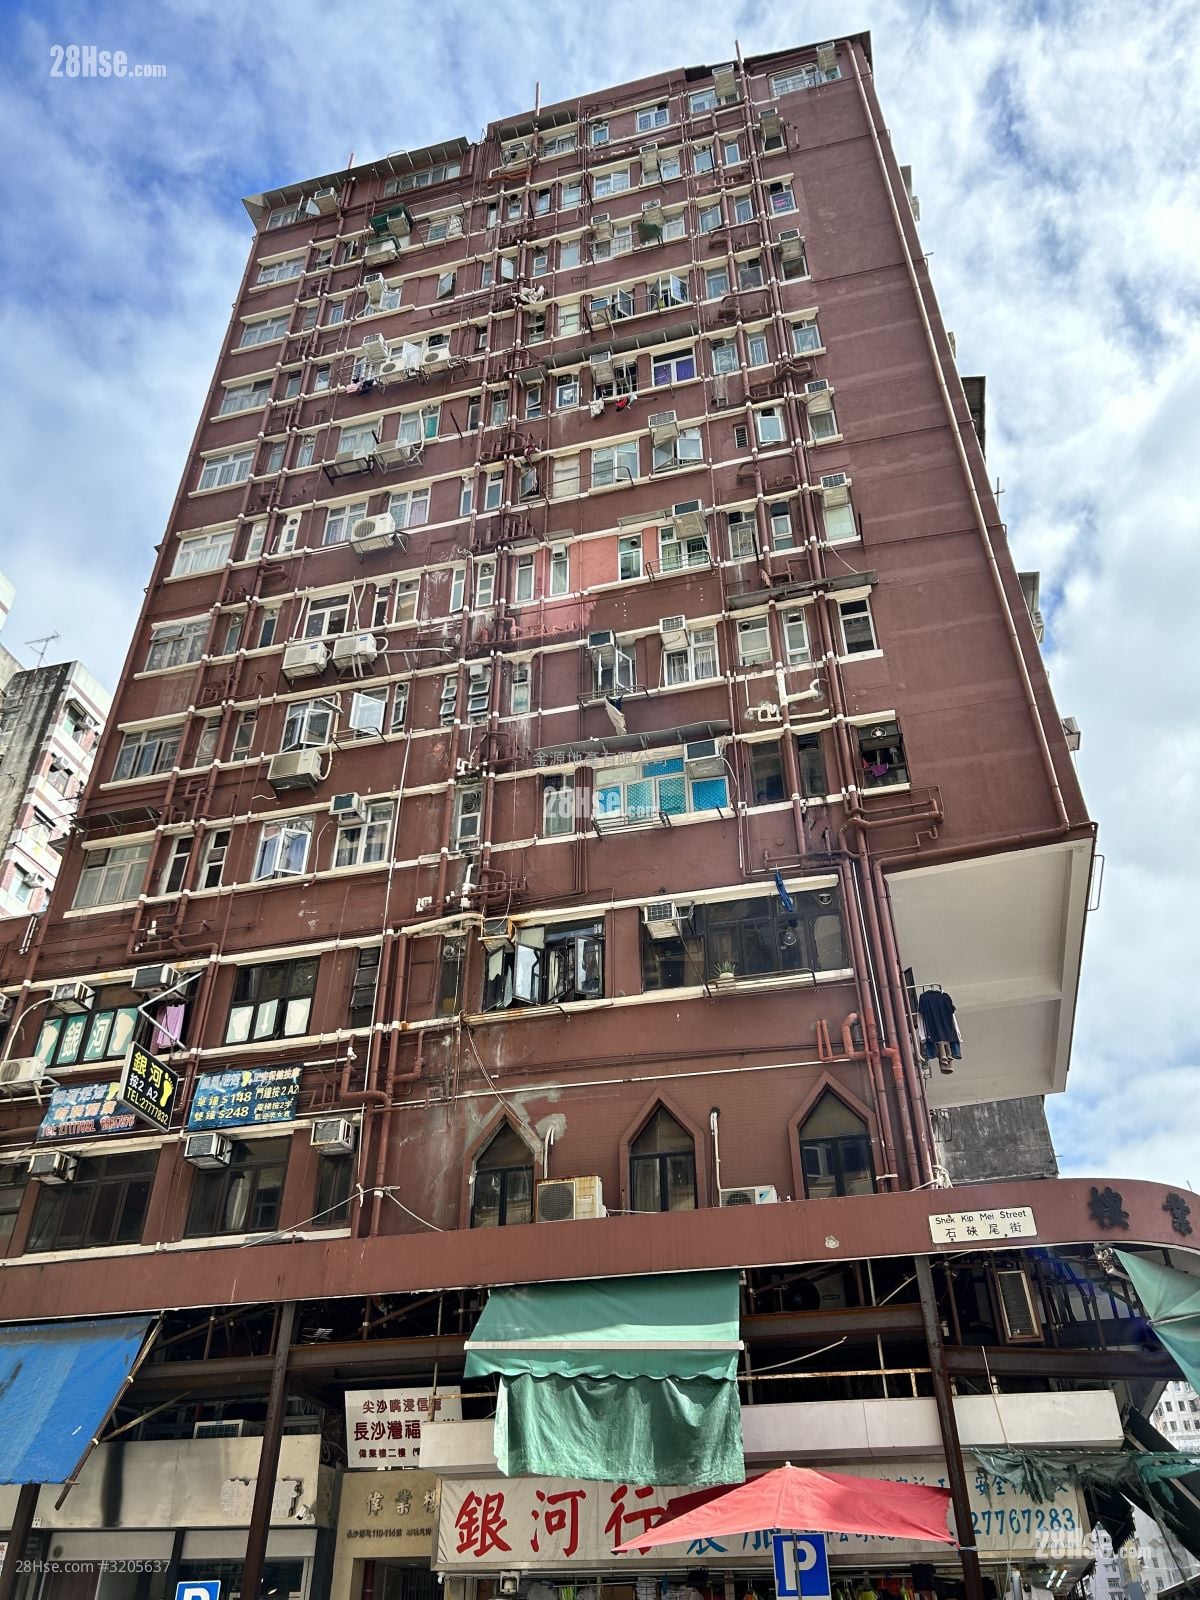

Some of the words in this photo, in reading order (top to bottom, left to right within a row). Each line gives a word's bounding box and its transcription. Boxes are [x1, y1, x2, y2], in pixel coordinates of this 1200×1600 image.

[61, 1018, 111, 1057] 銀河
[132, 1051, 163, 1088] 銀河
[129, 1072, 145, 1092] 按2
[146, 1087, 159, 1103] A2
[935, 1216, 955, 1225] Shek
[961, 1214, 974, 1223] Kip
[1000, 1209, 1027, 1219] Street
[354, 1419, 455, 1441] 長沙灣福
[972, 1507, 1076, 1537] 27767283
